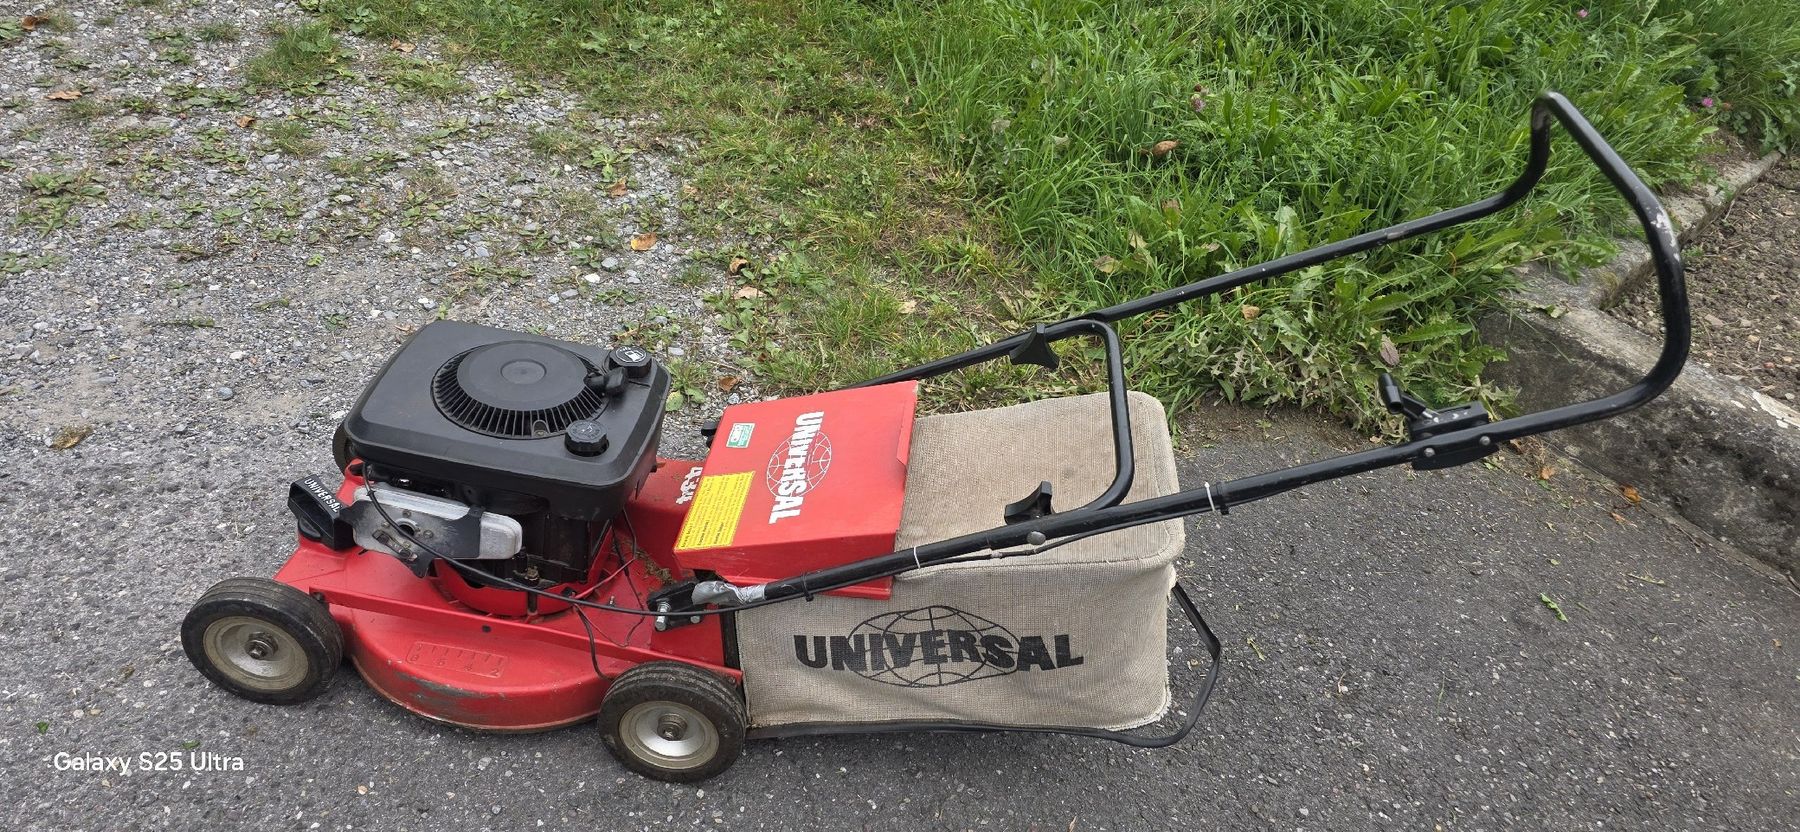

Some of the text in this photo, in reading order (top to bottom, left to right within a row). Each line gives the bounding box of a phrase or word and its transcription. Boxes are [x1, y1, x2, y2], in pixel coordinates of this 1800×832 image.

[769, 411, 825, 524] UNIVERSAL
[304, 478, 341, 513] UNIVERSAL
[793, 629, 1085, 672] UNIVERSAL
